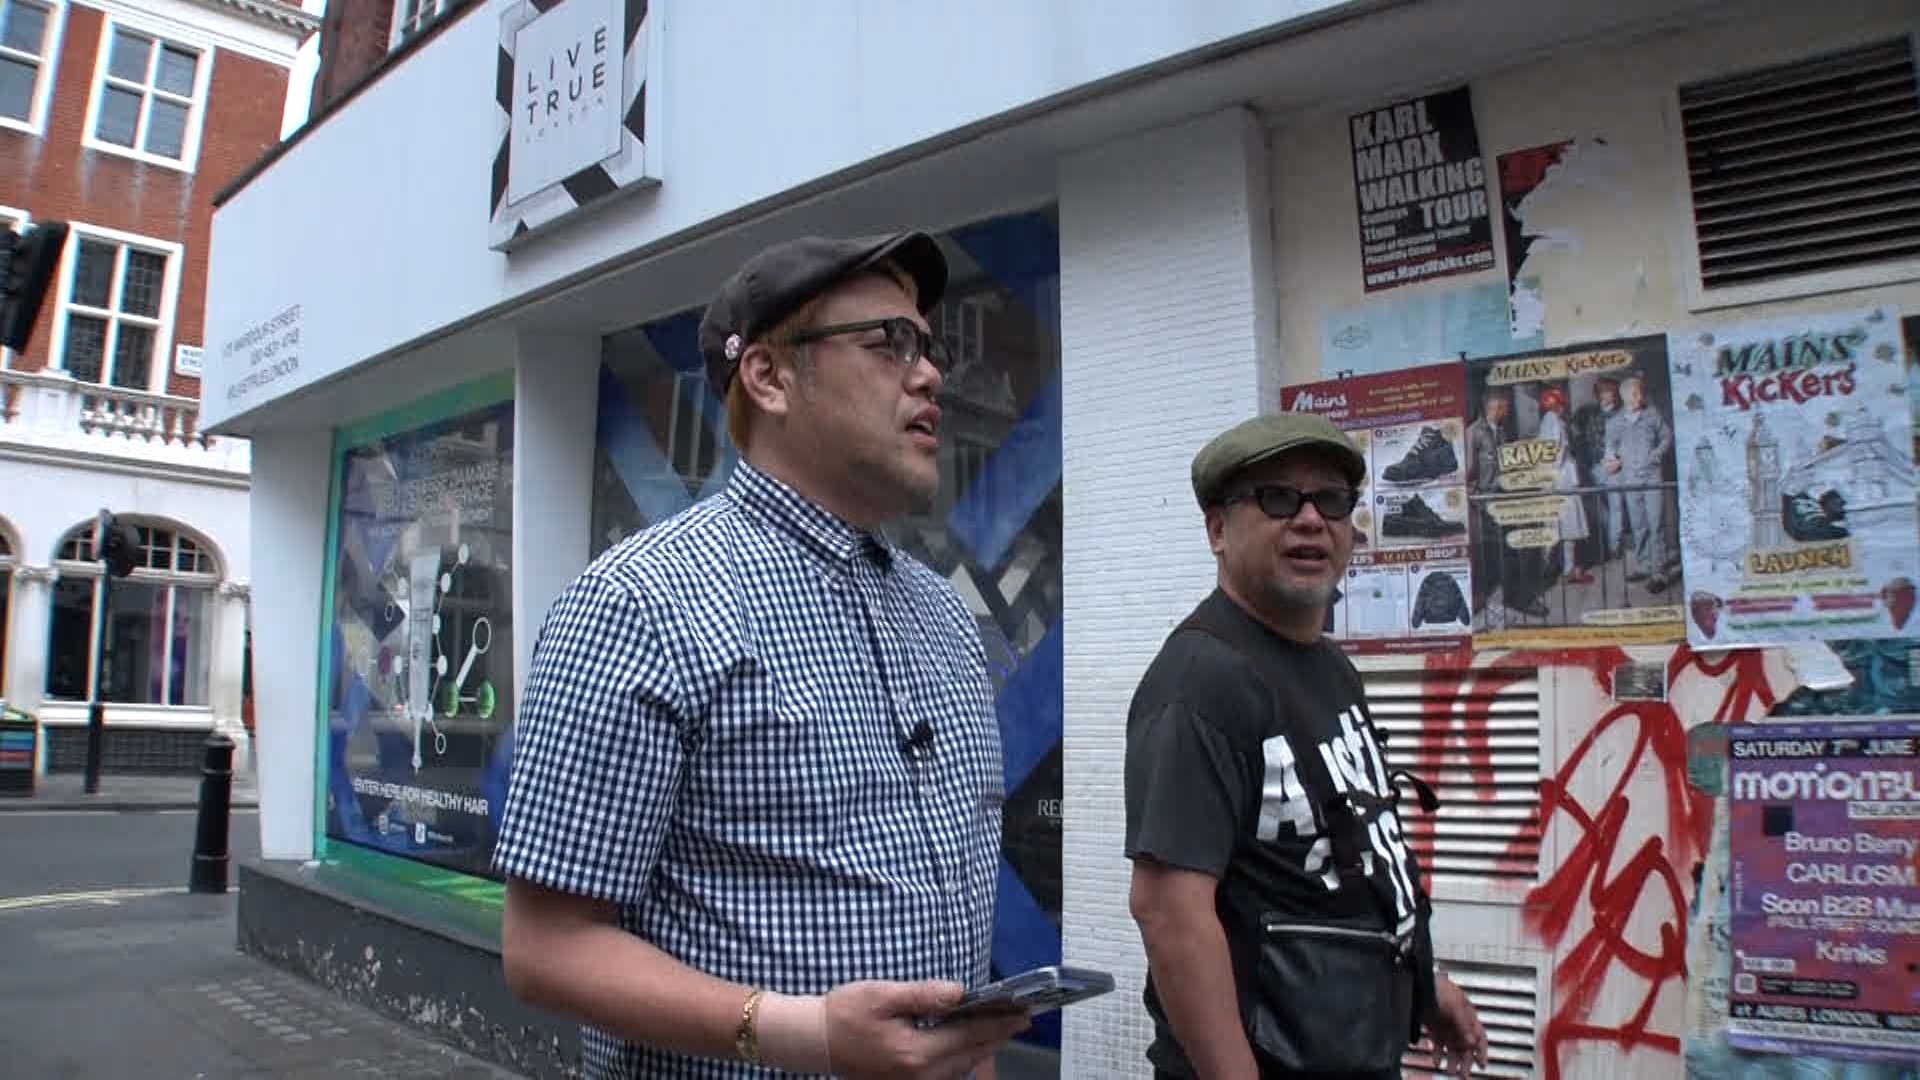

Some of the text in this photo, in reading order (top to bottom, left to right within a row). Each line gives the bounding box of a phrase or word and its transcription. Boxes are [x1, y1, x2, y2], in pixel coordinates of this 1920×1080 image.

[527, 26, 606, 94] LIVE
[527, 61, 605, 126] TRUE
[1352, 101, 1433, 148] KARL
[1356, 131, 1443, 182] MARX
[1360, 157, 1484, 212] WALKING
[1419, 190, 1487, 229] TOUR
[1715, 329, 1862, 379] MAINS
[1494, 361, 1553, 382] MAINS
[1291, 390, 1348, 414] Mains
[1501, 442, 1557, 469] RAVE
[1751, 543, 1850, 575] LAUNCH
[1733, 740, 1826, 757] SATURDAY
[1863, 739, 1914, 755] JUNE
[420, 788, 463, 811] HEALTHY
[463, 797, 489, 816] HAIR
[1784, 831, 1915, 859] Bruno Berry
[1822, 895, 1873, 917] B2B
